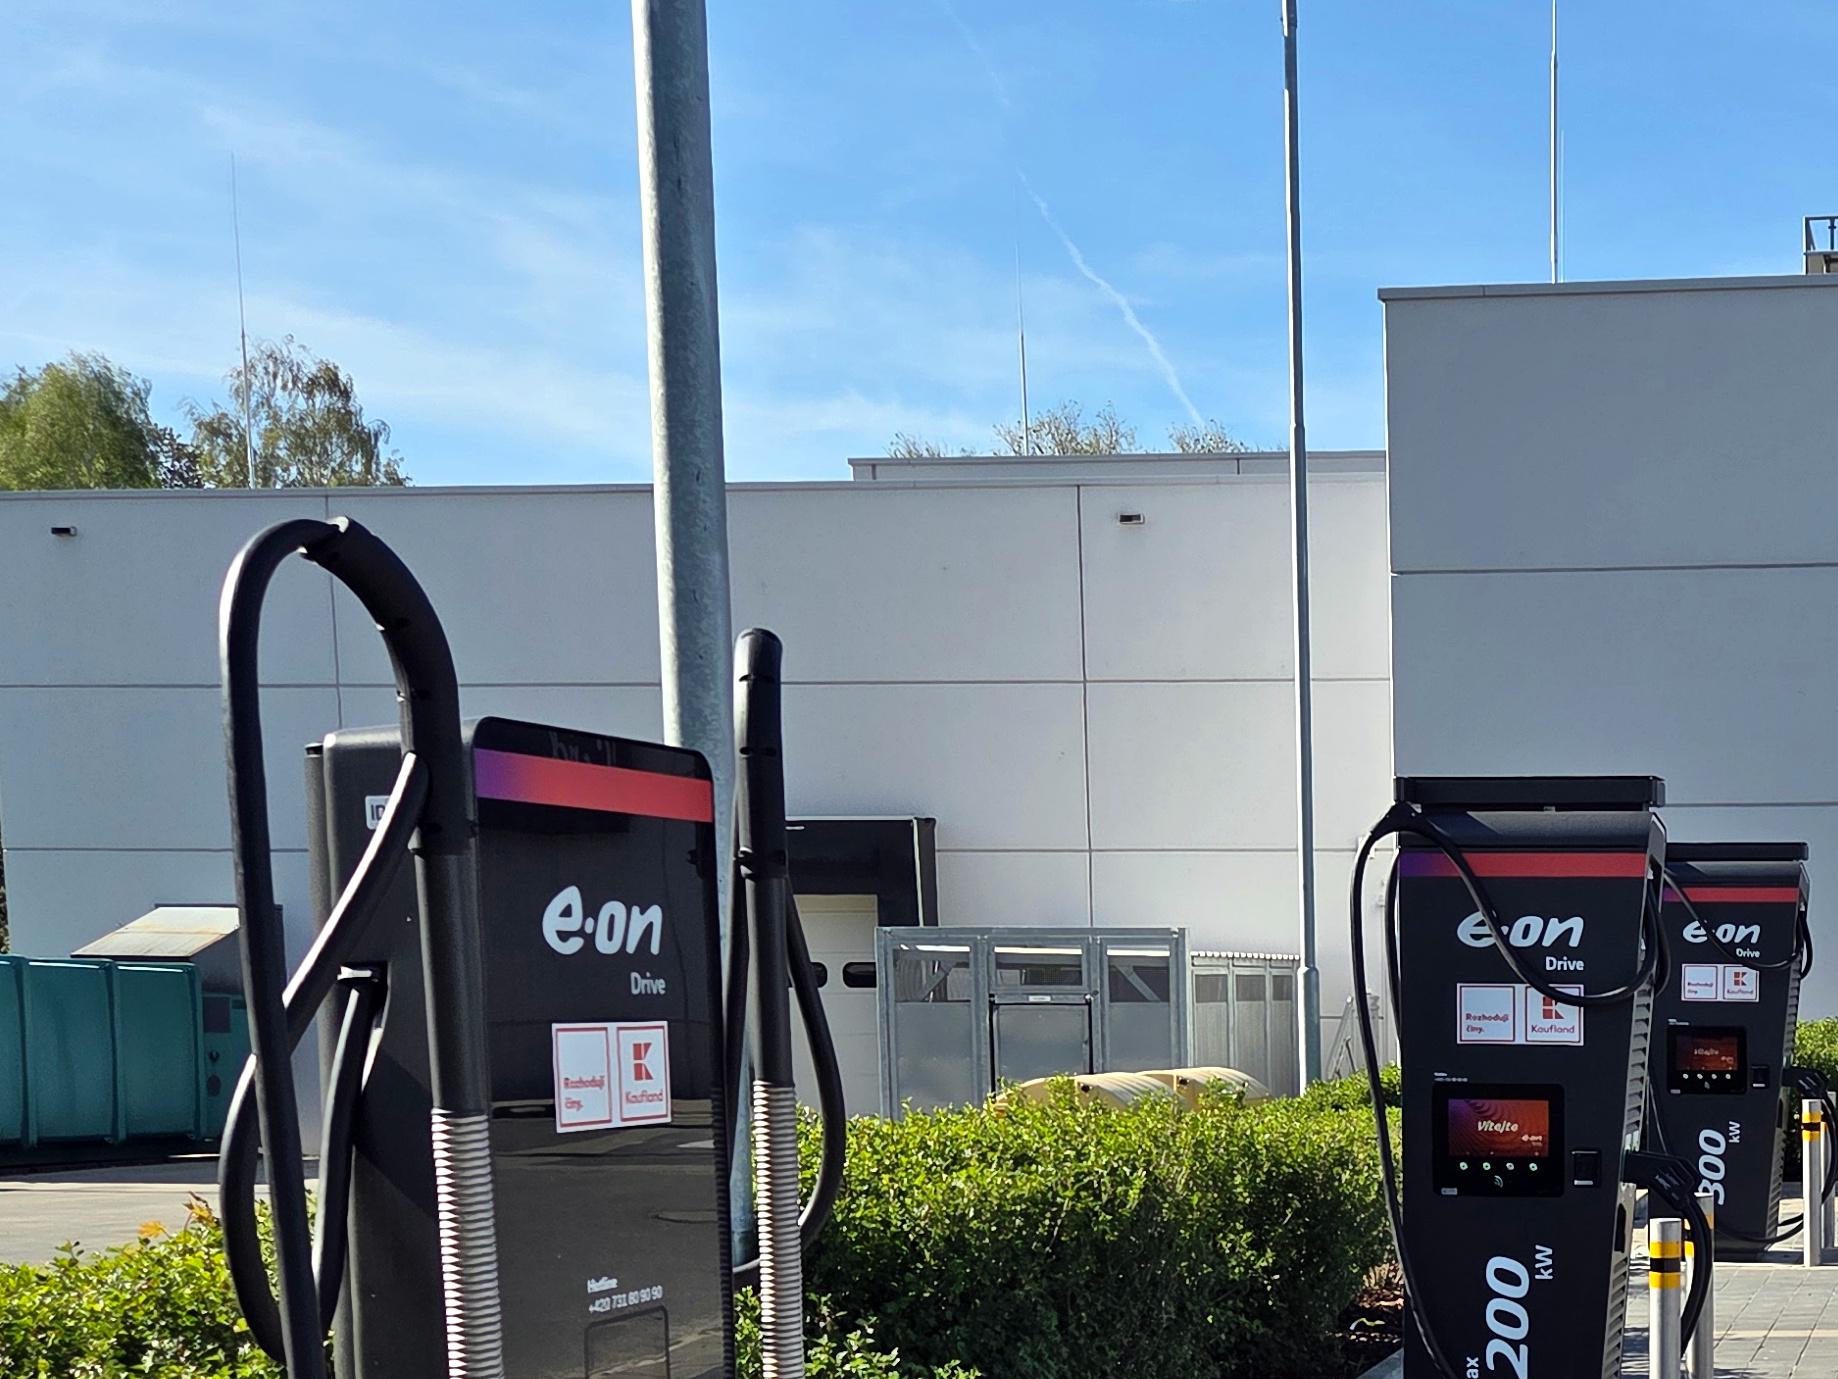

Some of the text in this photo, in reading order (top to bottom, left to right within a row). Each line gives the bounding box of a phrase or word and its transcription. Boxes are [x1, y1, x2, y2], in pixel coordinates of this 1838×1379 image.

[1545, 956, 1585, 971] Drive
[1736, 948, 1760, 958] Drive
[630, 971, 666, 995] Drive
[1531, 1024, 1576, 1034] Kaufland
[1728, 1121, 1740, 1143] kW
[1698, 1129, 1726, 1205] 300
[1535, 1244, 1553, 1280] kW
